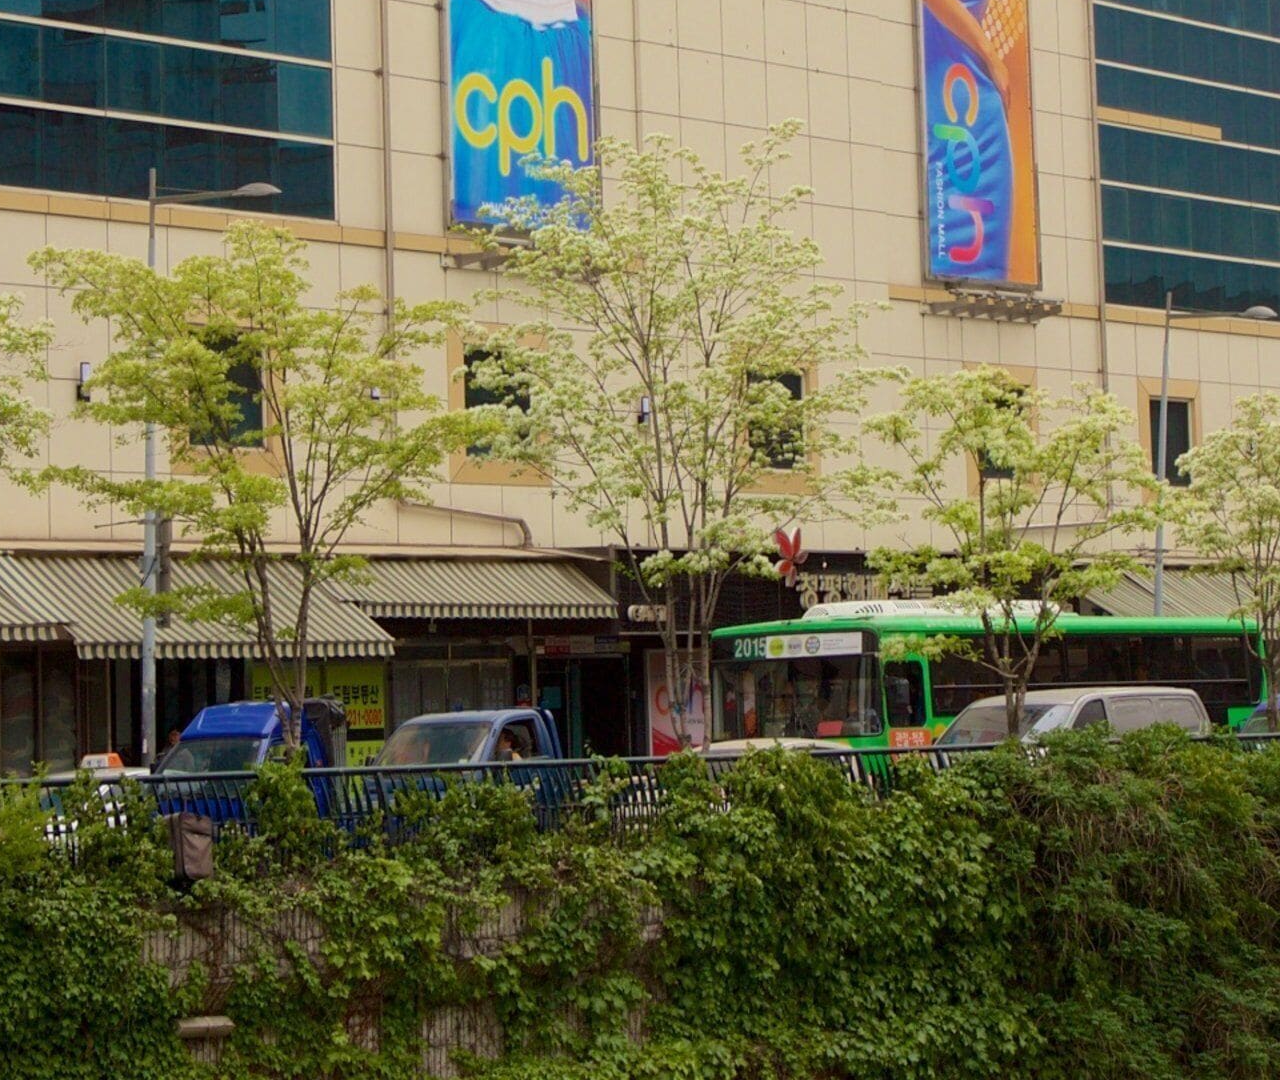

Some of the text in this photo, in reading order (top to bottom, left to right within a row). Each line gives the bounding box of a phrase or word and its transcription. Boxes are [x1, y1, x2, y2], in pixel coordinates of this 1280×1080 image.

[455, 56, 588, 176] cph
[933, 63, 995, 264] cph
[936, 161, 946, 259] FASHION MALL
